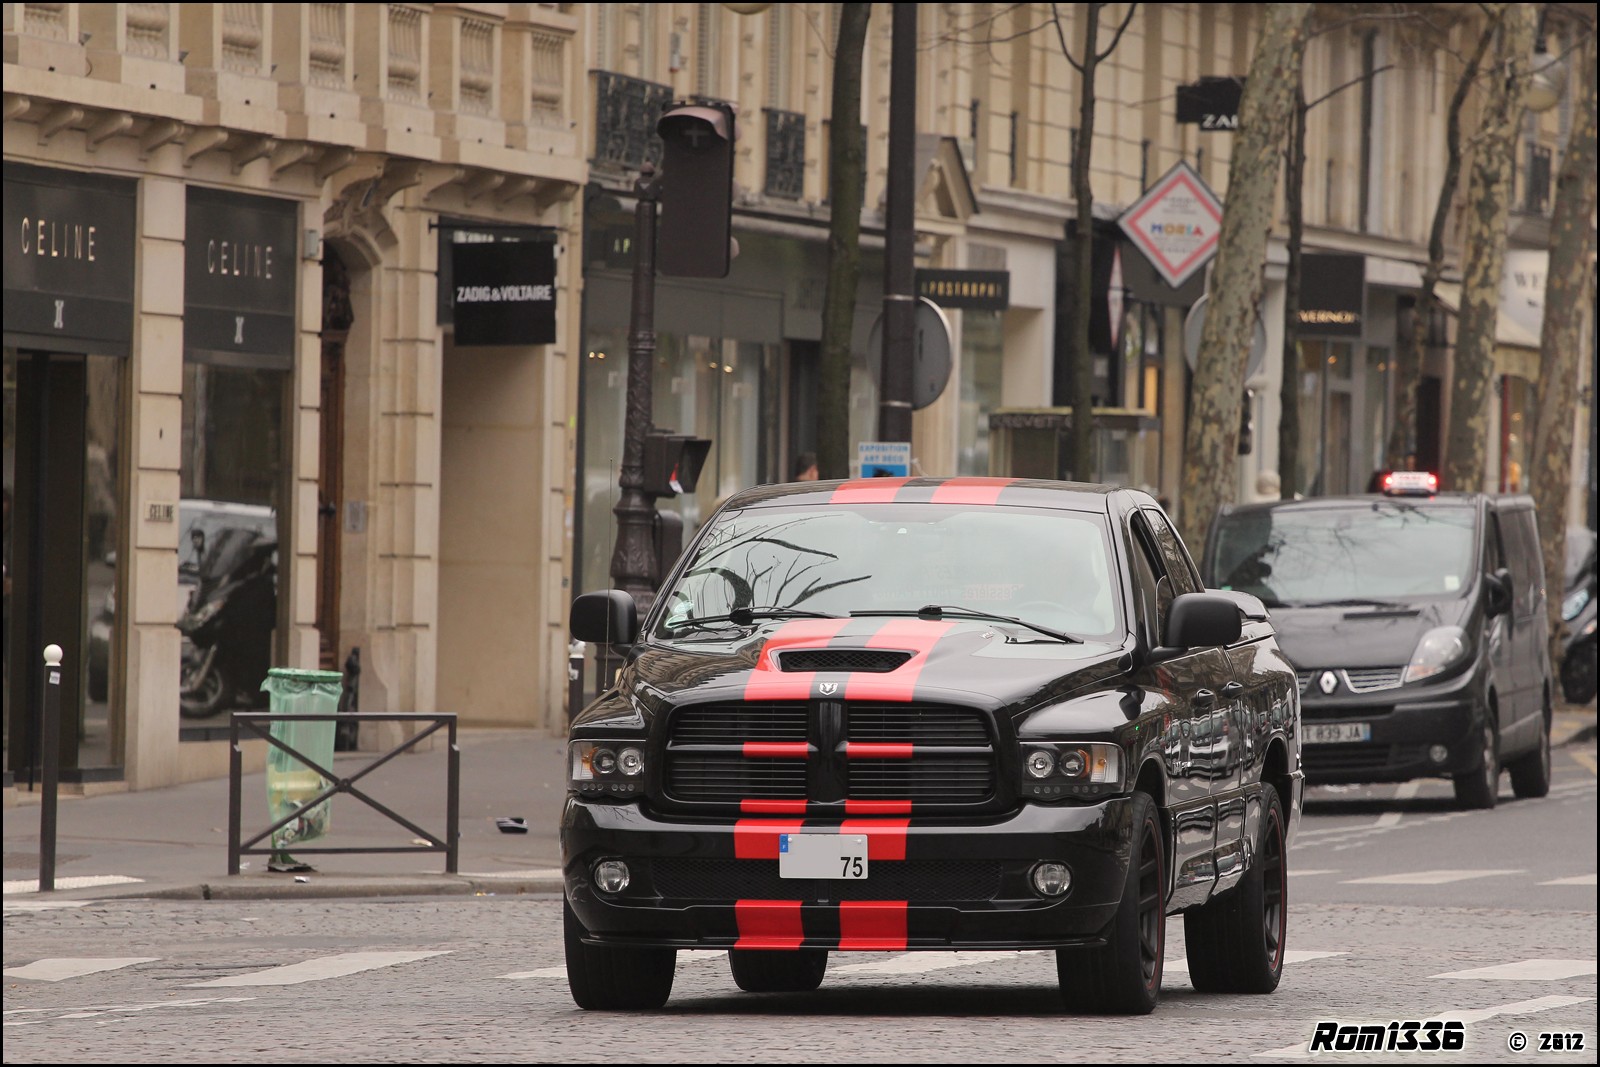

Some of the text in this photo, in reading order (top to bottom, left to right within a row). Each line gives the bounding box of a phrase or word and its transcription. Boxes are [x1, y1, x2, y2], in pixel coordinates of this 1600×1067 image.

[21, 217, 96, 262] CELINE
[207, 239, 273, 279] CELINE
[840, 856, 863, 877] 75
